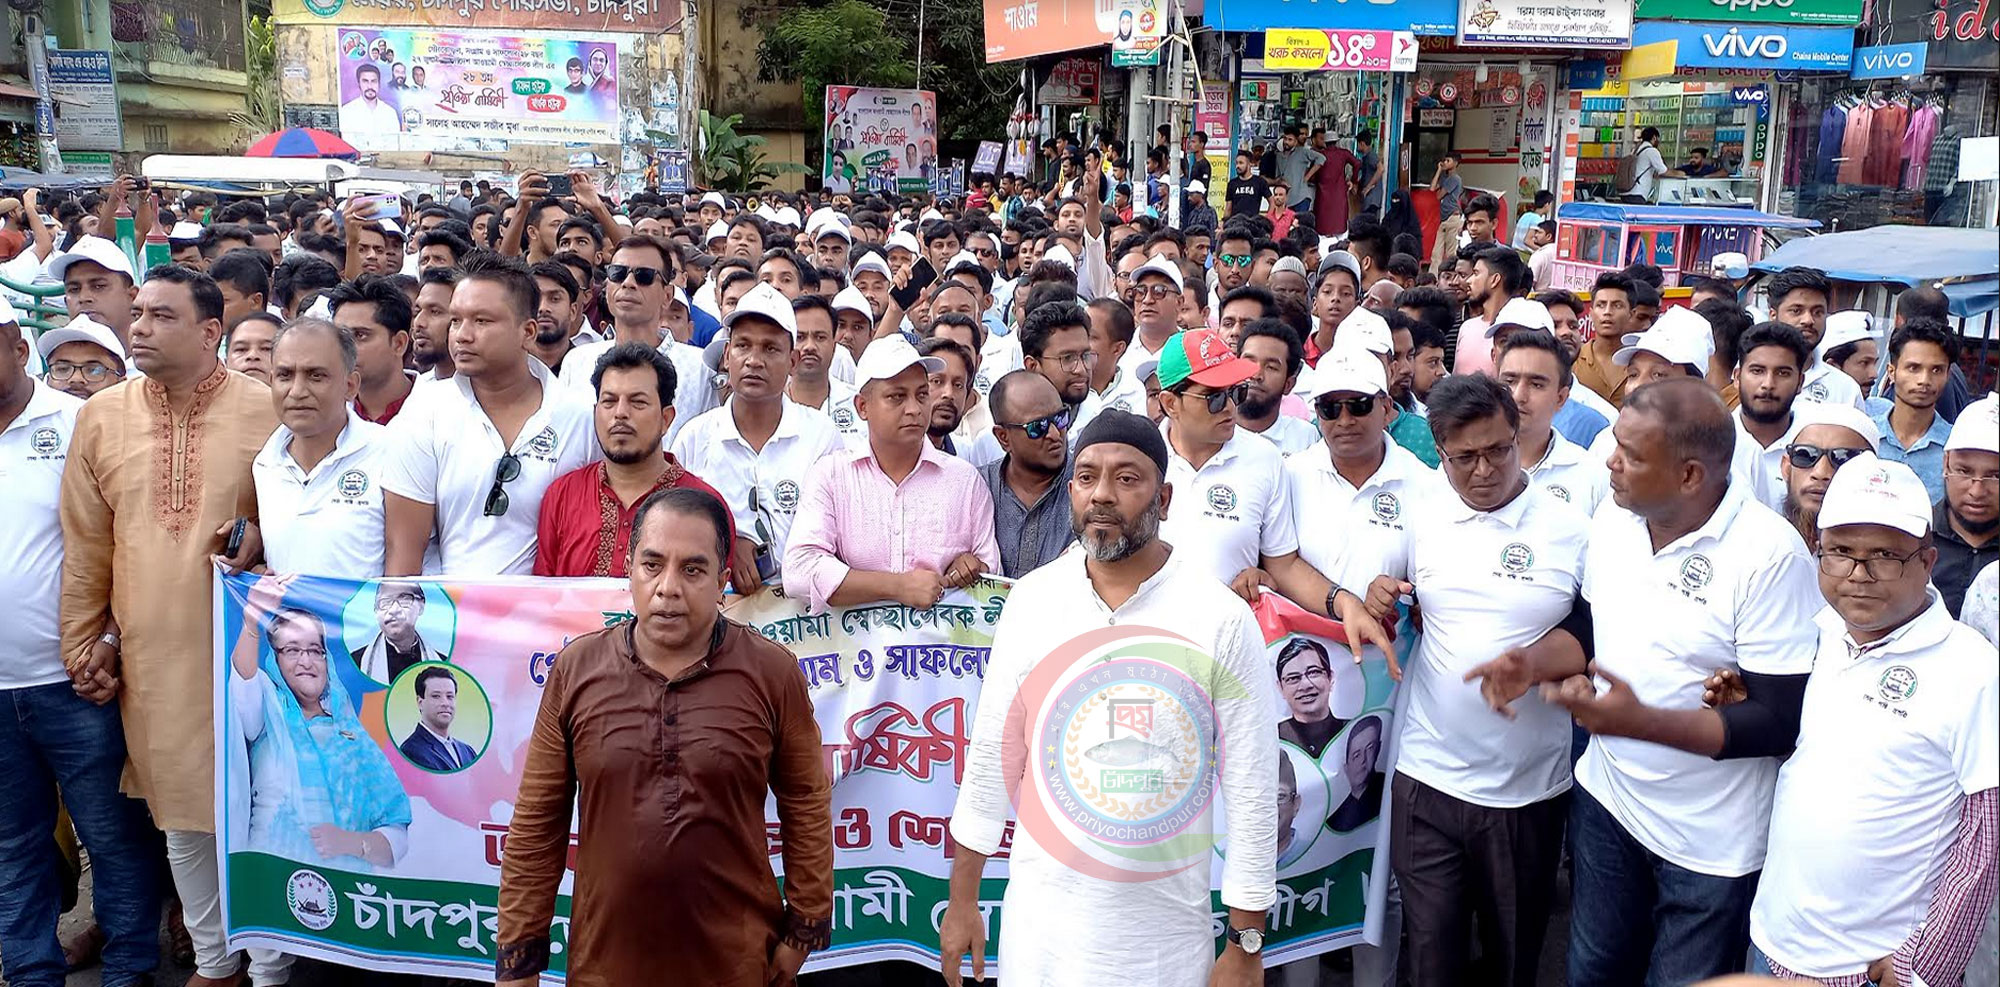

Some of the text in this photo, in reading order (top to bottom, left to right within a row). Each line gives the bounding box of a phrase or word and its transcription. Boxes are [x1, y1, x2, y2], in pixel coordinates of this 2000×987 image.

[420, 0, 489, 18] চাদপুর
[1269, 47, 1325, 59] খরচ কমলো
[1703, 26, 1788, 58] vivo
[1863, 50, 1913, 70] vivo
[853, 649, 874, 680] ও
[834, 808, 872, 848] ও
